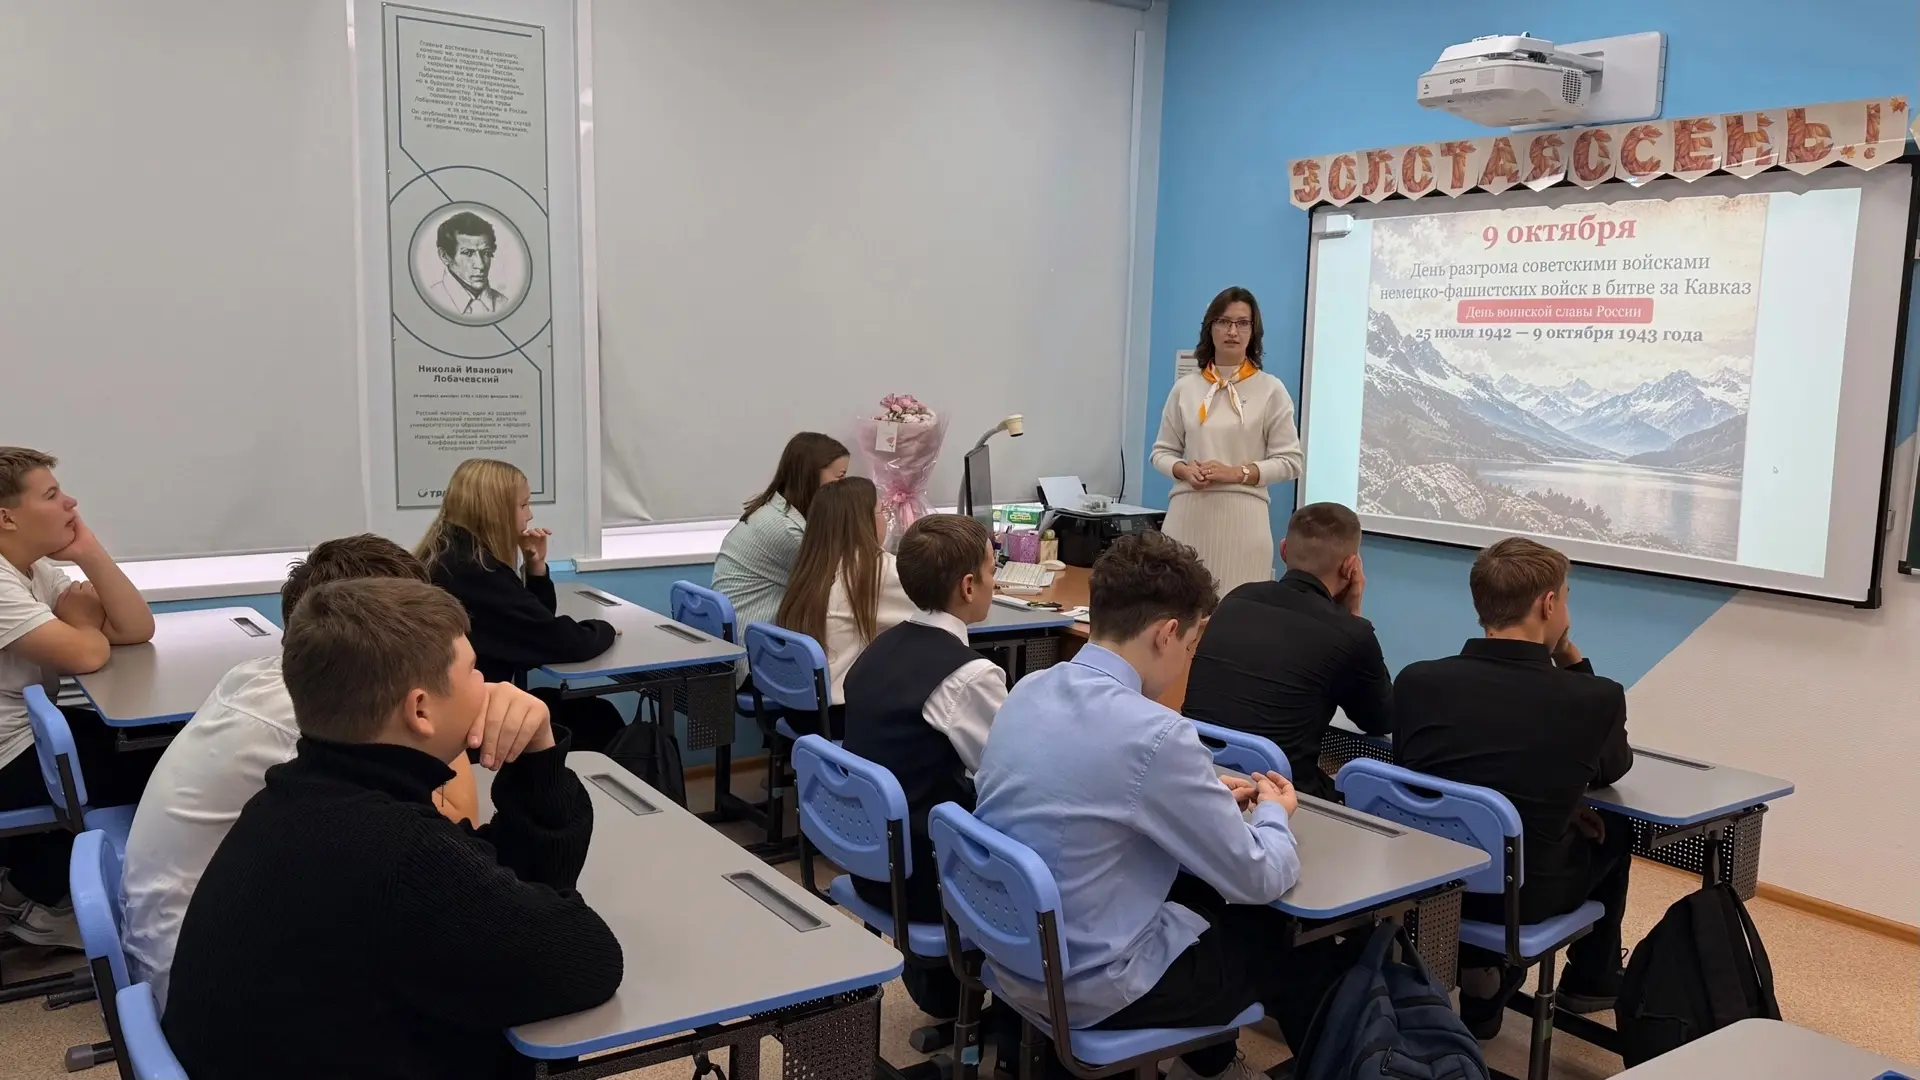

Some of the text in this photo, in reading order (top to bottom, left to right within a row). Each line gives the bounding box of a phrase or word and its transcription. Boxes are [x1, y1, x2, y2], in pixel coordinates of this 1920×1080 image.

[1449, 77, 1466, 85] EPSON
[1482, 213, 1637, 250] 9 октября
[1410, 254, 1710, 280] День разгрома советскими войсками
[1380, 278, 1752, 301] немецко-фашистских войск в битве за Кавказ
[1465, 305, 1642, 319] День воинской славы России
[1415, 328, 1431, 341] 25
[1435, 328, 1474, 339] июля
[1478, 328, 1512, 341] 1942
[1533, 328, 1542, 341] 9
[1547, 325, 1614, 343] октября
[1618, 329, 1657, 343] 1943
[1663, 330, 1703, 343] года
[418, 365, 513, 374] Николай Иванович
[433, 374, 498, 382] Лобачевский
